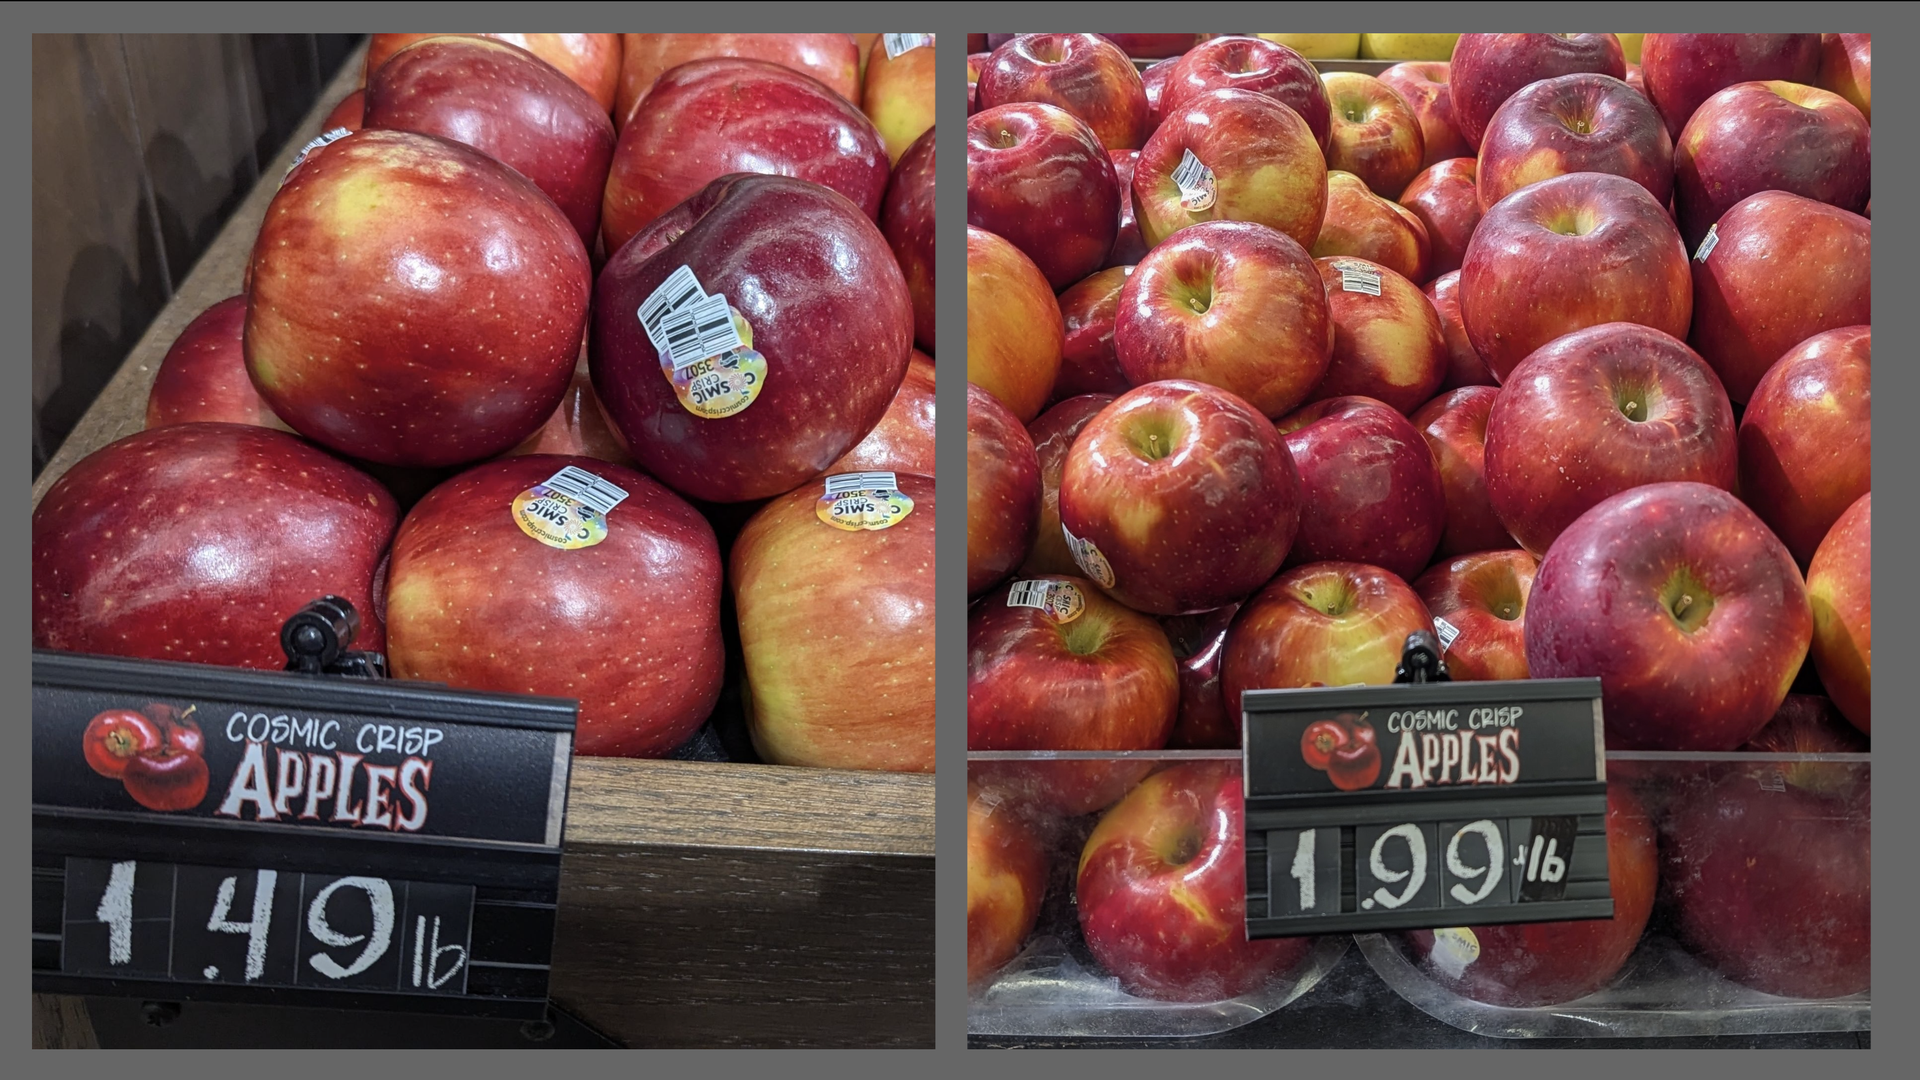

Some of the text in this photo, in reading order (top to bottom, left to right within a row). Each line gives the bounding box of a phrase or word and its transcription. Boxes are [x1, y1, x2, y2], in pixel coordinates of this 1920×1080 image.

[686, 359, 715, 380] 3507
[543, 489, 573, 507] 3507
[835, 490, 866, 500] 3507
[226, 711, 444, 755] COSMIC CRISP
[1387, 705, 1524, 733] COSMIC CRISP
[1385, 728, 1521, 790] APPLES
[214, 739, 434, 832] APPLES
[1526, 834, 1566, 883] lb
[411, 915, 467, 990] lb
